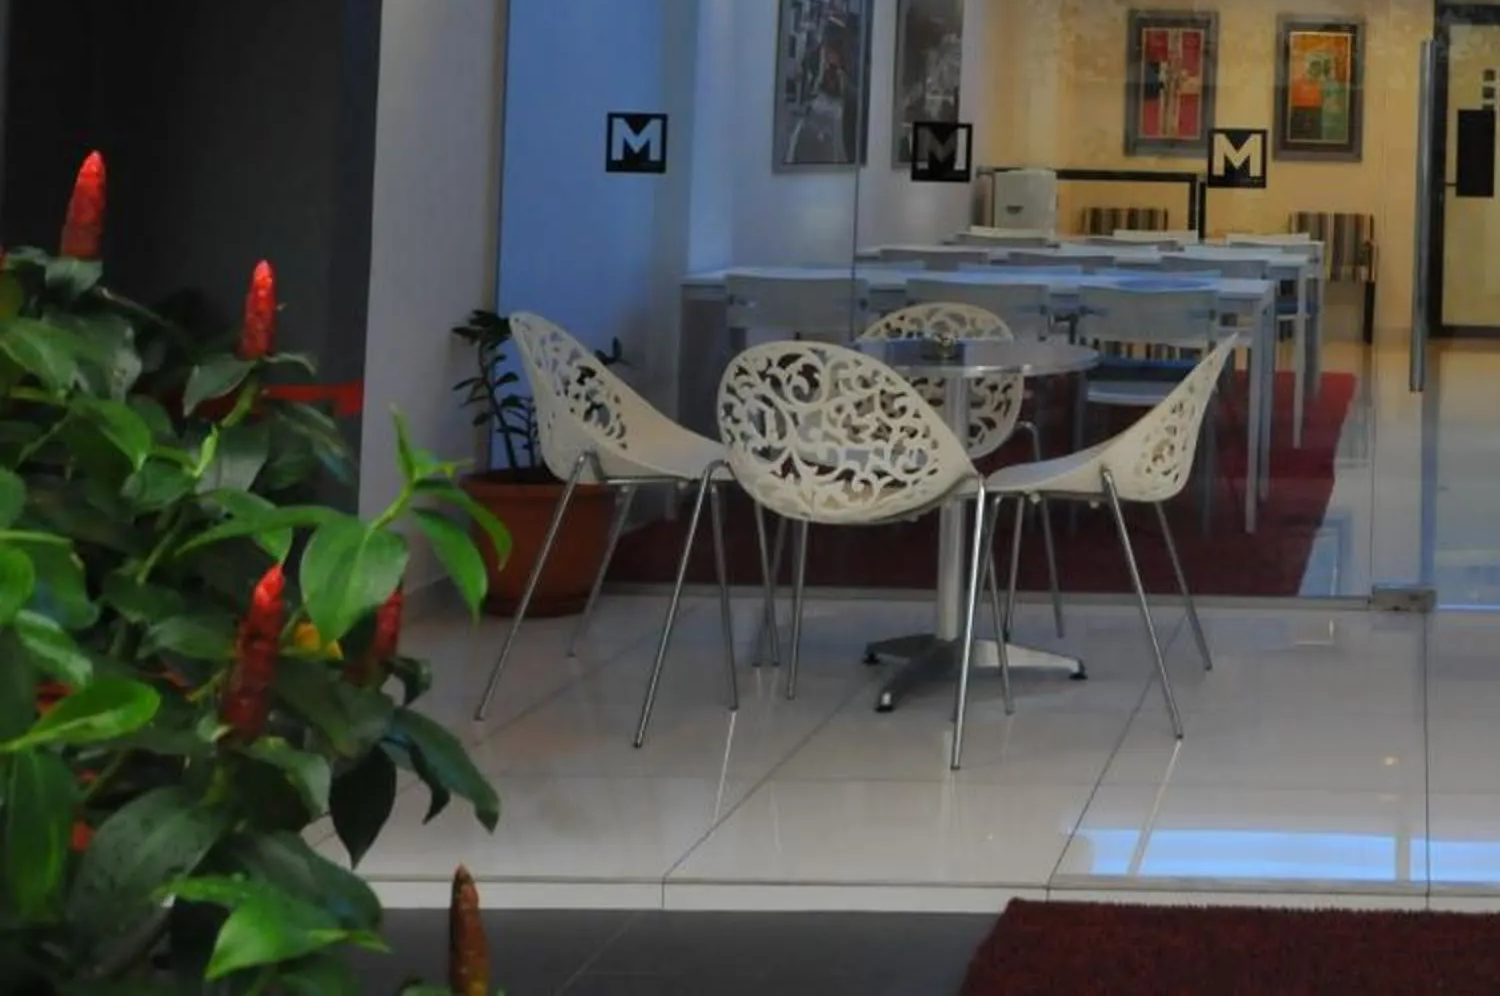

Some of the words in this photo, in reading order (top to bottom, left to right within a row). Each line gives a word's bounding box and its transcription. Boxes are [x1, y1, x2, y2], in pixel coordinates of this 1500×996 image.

[611, 116, 663, 161] M
[917, 127, 968, 171] M
[1213, 133, 1262, 176] M
